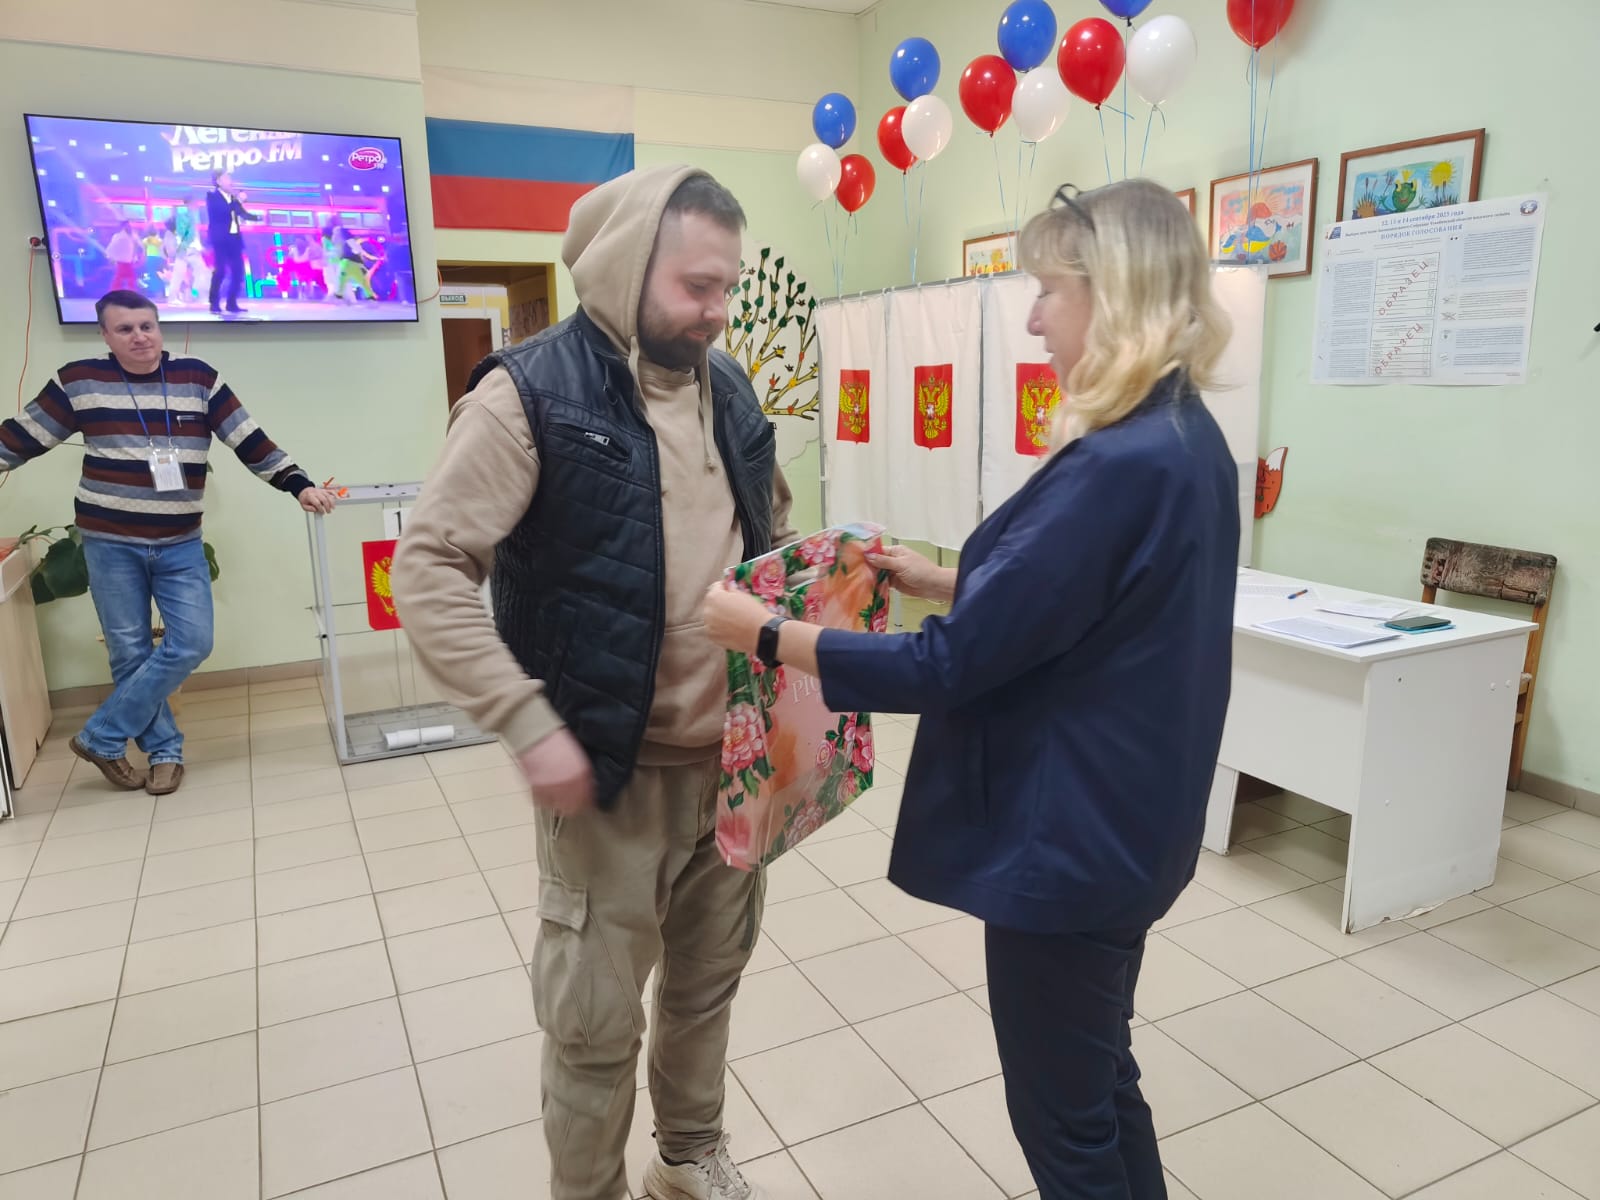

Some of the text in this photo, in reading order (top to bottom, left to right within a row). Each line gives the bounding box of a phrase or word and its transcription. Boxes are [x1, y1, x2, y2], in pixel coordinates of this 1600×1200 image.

[172, 139, 302, 173] Ретро FM
[352, 152, 382, 165] Ретро
[1436, 211, 1450, 219] 2025
[1380, 230, 1409, 240] ПОРЯДОК
[1411, 223, 1463, 237] ГОЛОСОВАНИЯ
[1378, 261, 1429, 316] ОБРАЗЕЦ
[1374, 323, 1423, 375] ОБРАЗЕЦ
